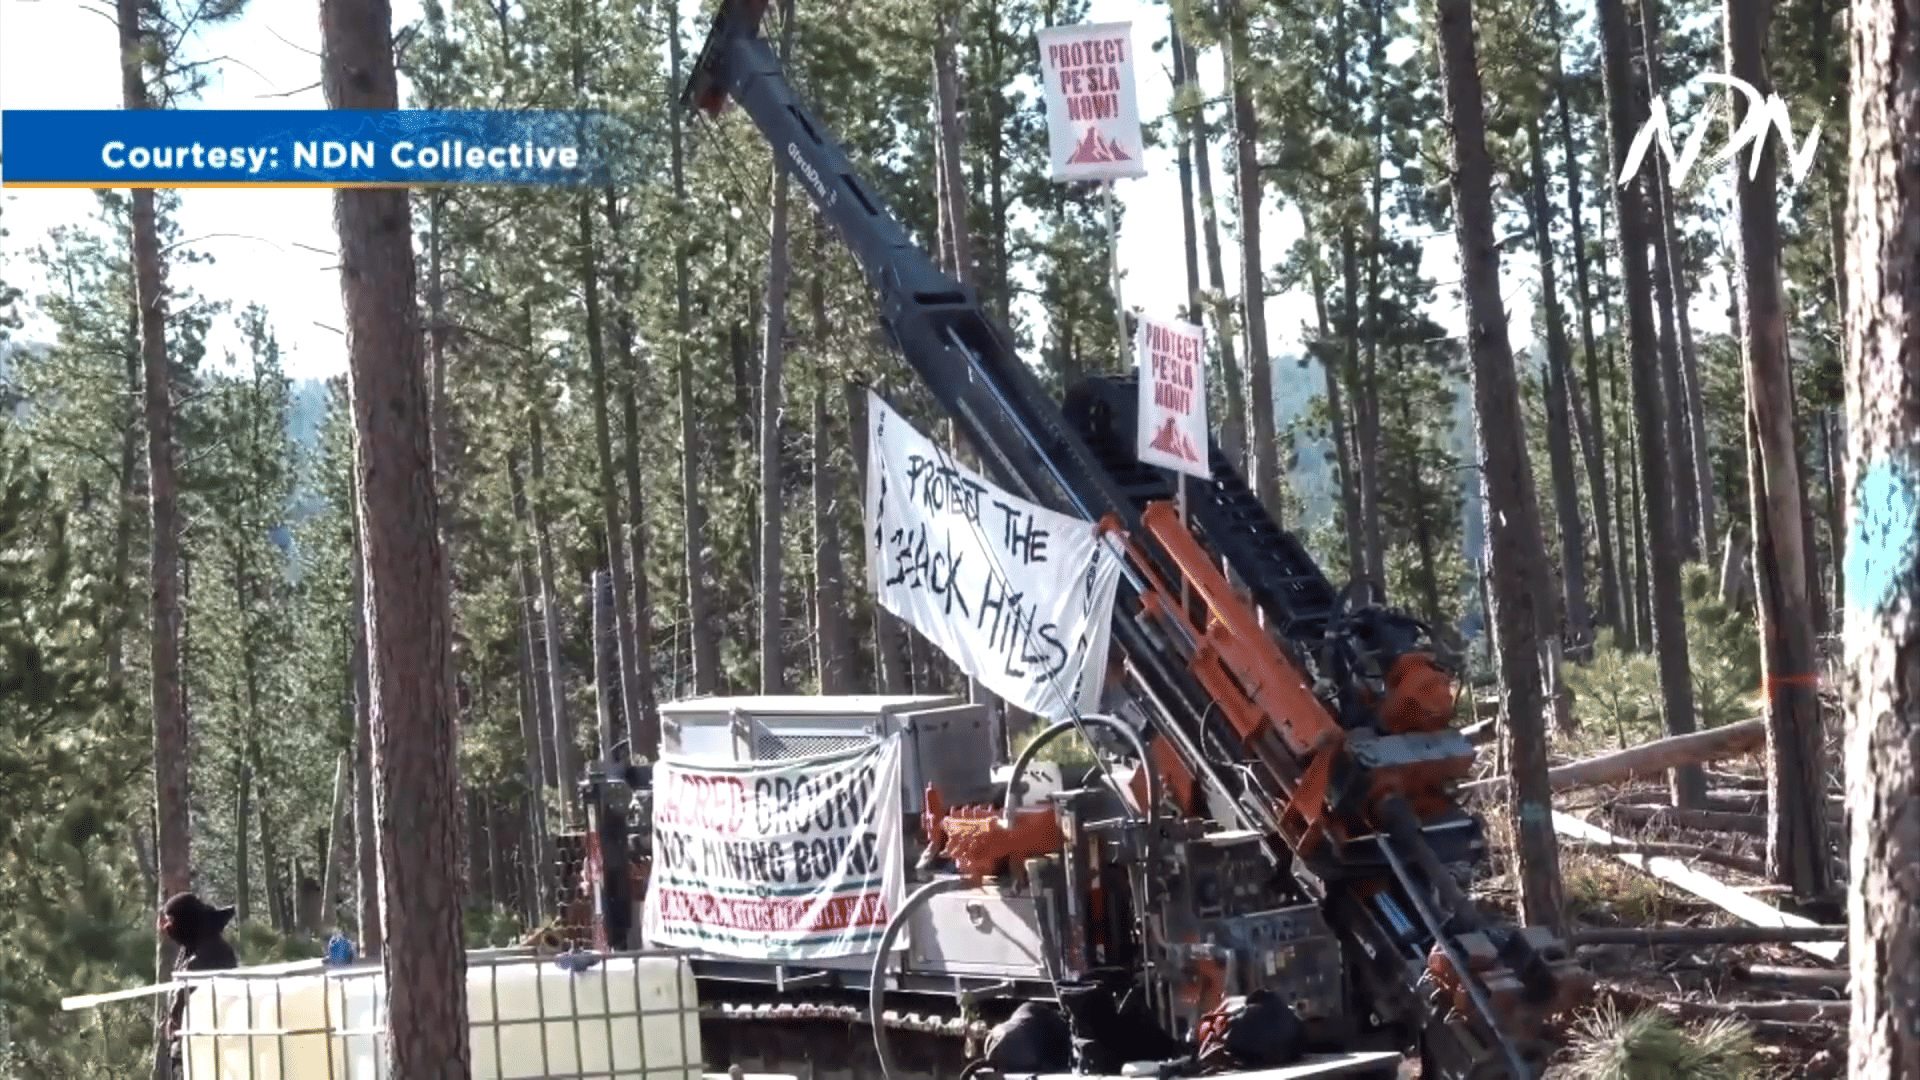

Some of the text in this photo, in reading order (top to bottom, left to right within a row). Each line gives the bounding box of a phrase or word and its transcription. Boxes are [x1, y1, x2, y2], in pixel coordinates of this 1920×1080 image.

[1048, 38, 1124, 69] PROTECT
[1060, 67, 1120, 95] PE'SLA
[1067, 93, 1119, 121] NOW!
[1146, 322, 1199, 364] PROTECT
[1154, 382, 1190, 416] NOW!
[906, 455, 1049, 565] PROTECT THE
[978, 570, 1068, 683] HILLS
[655, 765, 876, 834] ACRED GROUND
[702, 837, 785, 882] MINING
[793, 832, 878, 883] BOUND
